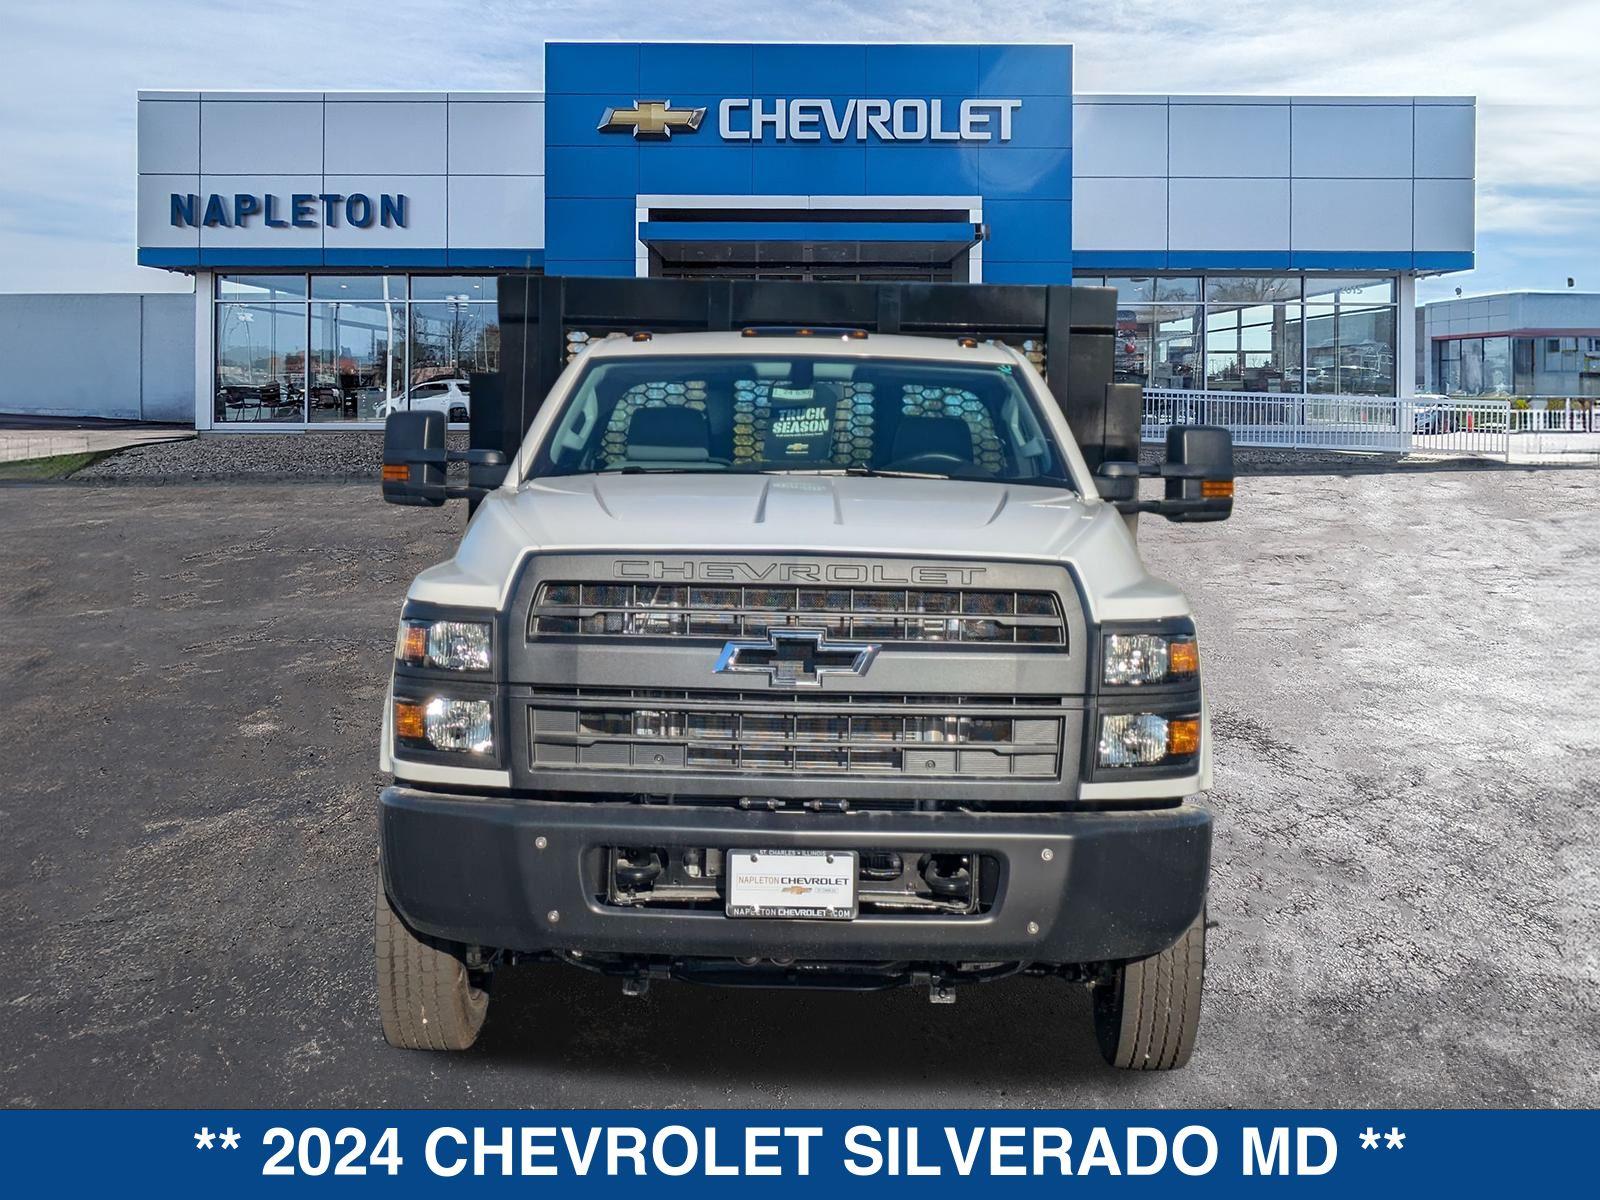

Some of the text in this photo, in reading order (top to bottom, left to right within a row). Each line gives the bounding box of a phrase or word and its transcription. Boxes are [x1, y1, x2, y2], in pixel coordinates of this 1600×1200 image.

[719, 98, 1022, 141] CHEVROLET
[170, 193, 408, 229] NAPLETON
[778, 407, 826, 421] TRUCK
[772, 419, 829, 433] SEASON
[613, 560, 987, 585] CHEVROLET
[738, 876, 849, 886] NAPLETON CHEVROLET
